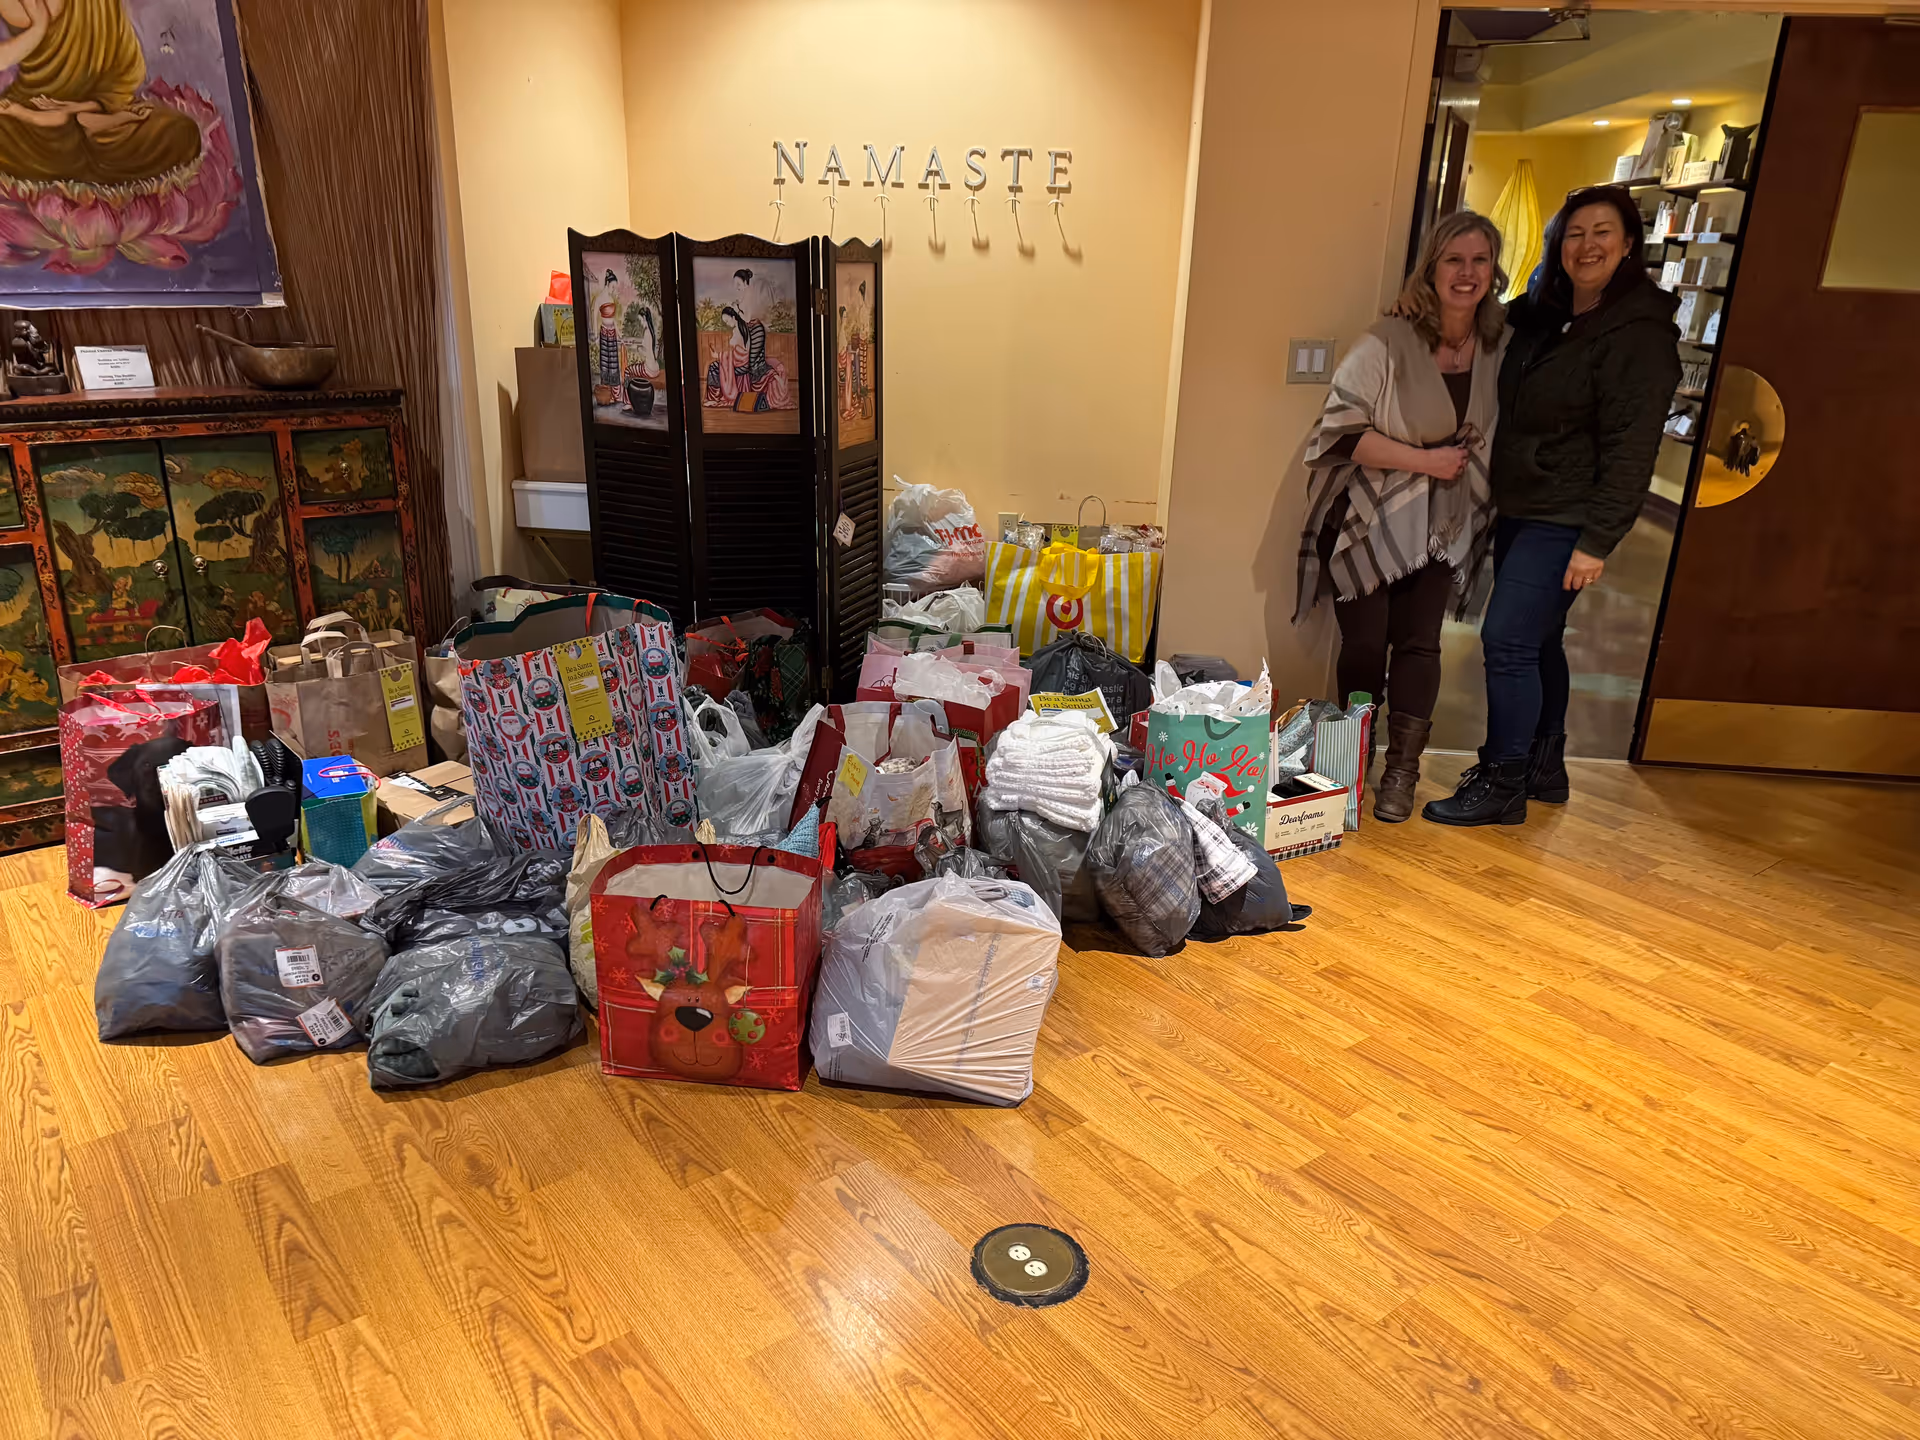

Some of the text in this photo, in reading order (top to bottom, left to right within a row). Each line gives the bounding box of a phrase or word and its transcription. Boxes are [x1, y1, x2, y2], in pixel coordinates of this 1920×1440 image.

[773, 140, 1073, 193] NAMASTE
[566, 666, 573, 674] Be
[577, 662, 593, 671] Santa
[578, 669, 594, 678] Senior
[1146, 744, 1178, 775] Ho
[1182, 740, 1221, 774] Ho
[1220, 744, 1268, 784] Ho!
[1279, 810, 1326, 826] Dearfoams
[1280, 844, 1301, 852] MEMORY
